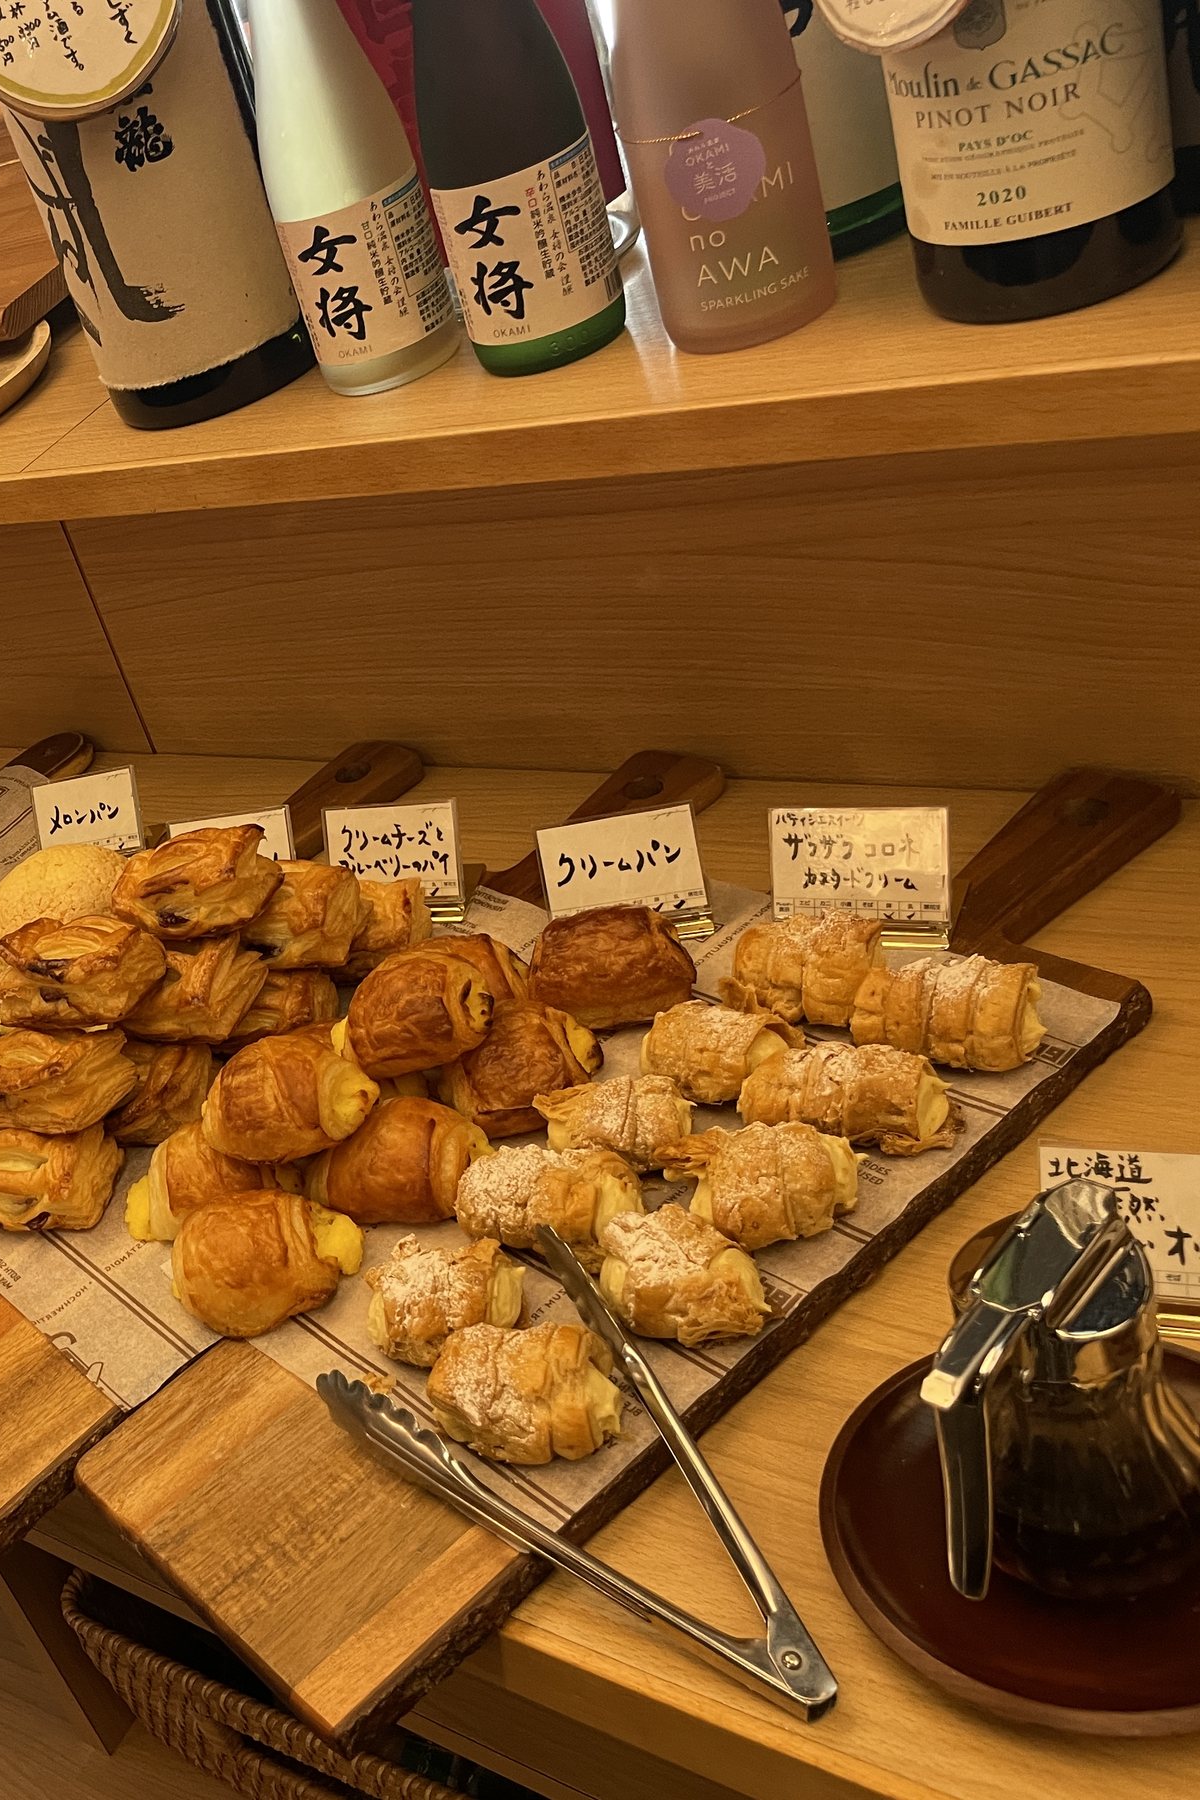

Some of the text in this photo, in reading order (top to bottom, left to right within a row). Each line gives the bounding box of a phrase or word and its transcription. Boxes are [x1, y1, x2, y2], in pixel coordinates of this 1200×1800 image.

[989, 22, 1124, 90] GASSAC
[915, 82, 1082, 130] PINOT NOIR
[112, 84, 176, 172] 龍
[959, 130, 1034, 152] PAYS D'OC
[685, 143, 730, 167] OKAMI
[693, 161, 737, 195] 美活
[976, 185, 1027, 207] 2020
[944, 201, 1074, 231] FAMILLE GUIBERT
[454, 194, 534, 320] 女将
[689, 230, 726, 252] no
[297, 225, 373, 341] 女将
[697, 246, 779, 288] AWA
[701, 266, 809, 312] SPARKLING SAKE
[493, 324, 531, 339] OKAMI
[338, 345, 373, 359] OKAMI
[49, 802, 119, 835] メロンパン
[341, 821, 444, 853] クリームチーズと
[782, 832, 921, 868] ザクザク コロネ
[557, 839, 681, 887] クリームパン
[803, 867, 919, 891] カスタードクリーム
[857, 1170, 885, 1185] USED
[859, 1159, 892, 1176] SIDES
[1047, 1151, 1153, 1185] 北海道
